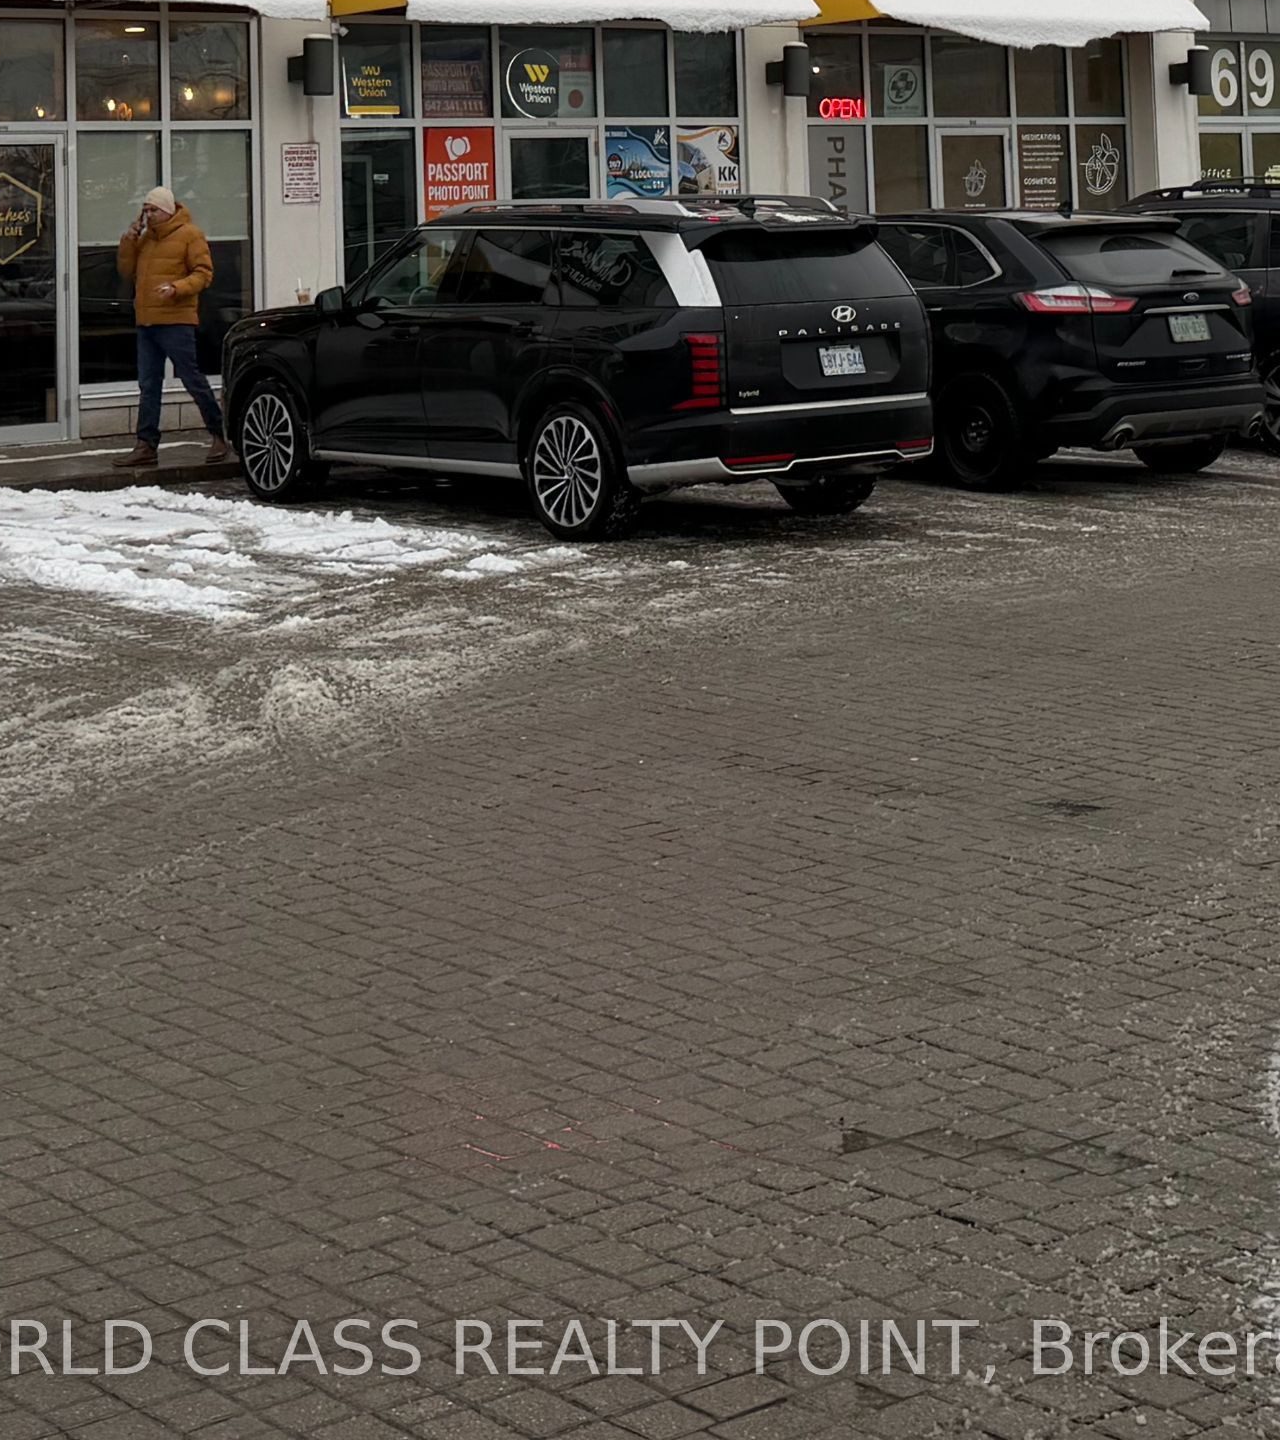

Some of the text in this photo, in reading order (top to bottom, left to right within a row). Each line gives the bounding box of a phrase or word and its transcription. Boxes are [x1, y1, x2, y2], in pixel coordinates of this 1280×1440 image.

[351, 76, 393, 87] Western
[1209, 47, 1275, 108] 69
[358, 88, 387, 98] Union
[518, 82, 557, 95] Western
[524, 93, 552, 104] Union
[819, 97, 862, 119] OPEN
[1021, 133, 1061, 141] MEDICATIONS
[427, 162, 489, 182] PASSPORT
[717, 165, 737, 182] KK
[1023, 177, 1057, 186] COSMETICS
[428, 184, 490, 201] PHOTO POINT
[4, 226, 24, 237] CAFE
[778, 322, 901, 337] PALISADE
